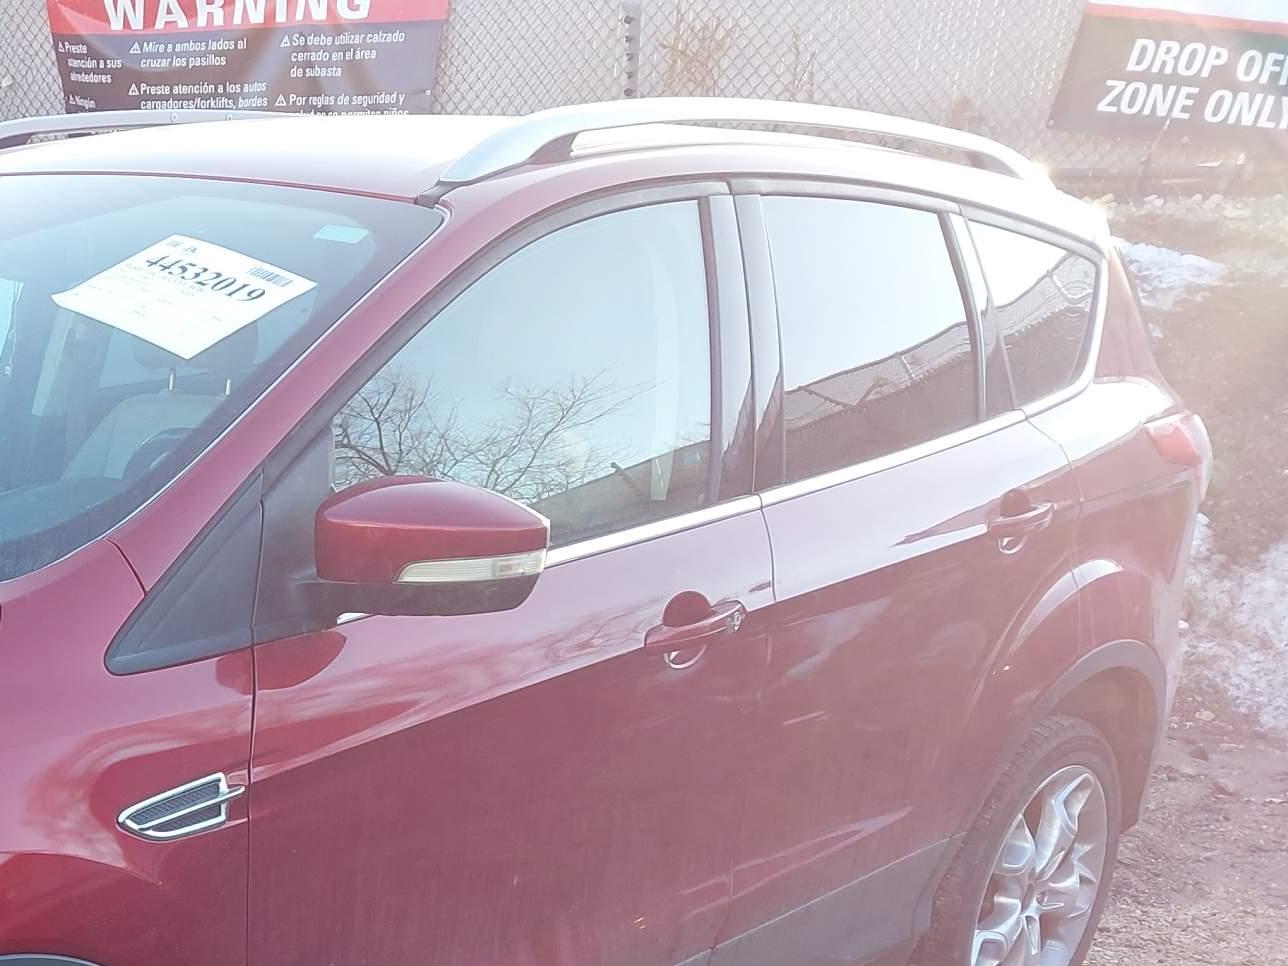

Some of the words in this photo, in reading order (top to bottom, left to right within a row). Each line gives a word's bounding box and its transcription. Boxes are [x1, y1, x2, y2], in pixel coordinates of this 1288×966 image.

[142, 42, 165, 53] Mire
[167, 43, 173, 52] a
[175, 40, 206, 51] ambos
[208, 38, 235, 50] lados
[237, 37, 247, 49] al
[292, 34, 305, 46] Se
[307, 33, 333, 46] debe
[335, 32, 365, 45] utilizar
[367, 30, 405, 43] calzado
[65, 42, 87, 54] Preste
[291, 49, 329, 61] cerrado
[331, 50, 344, 61] en
[345, 47, 353, 60] el
[355, 47, 377, 59] área
[99, 60, 105, 68] a
[106, 59, 122, 68] sus
[140, 58, 171, 68] cruzar
[173, 55, 187, 66] los
[189, 54, 227, 68] pasillos
[1126, 38, 1229, 78] DROP
[290, 65, 303, 77] de
[305, 65, 342, 77] subasta
[140, 83, 171, 95] Preste
[172, 82, 214, 94] atención
[217, 83, 223, 93] a
[226, 81, 241, 93] los
[243, 81, 267, 93] autos
[140, 97, 236, 110] cargadores/forklifts,
[238, 95, 268, 107] bordes
[289, 94, 306, 106] Por
[308, 93, 335, 108] reglas
[337, 92, 350, 105] de
[399, 93, 405, 105] y
[1096, 79, 1200, 120] ZONE
[145, 255, 266, 302] 44532019
